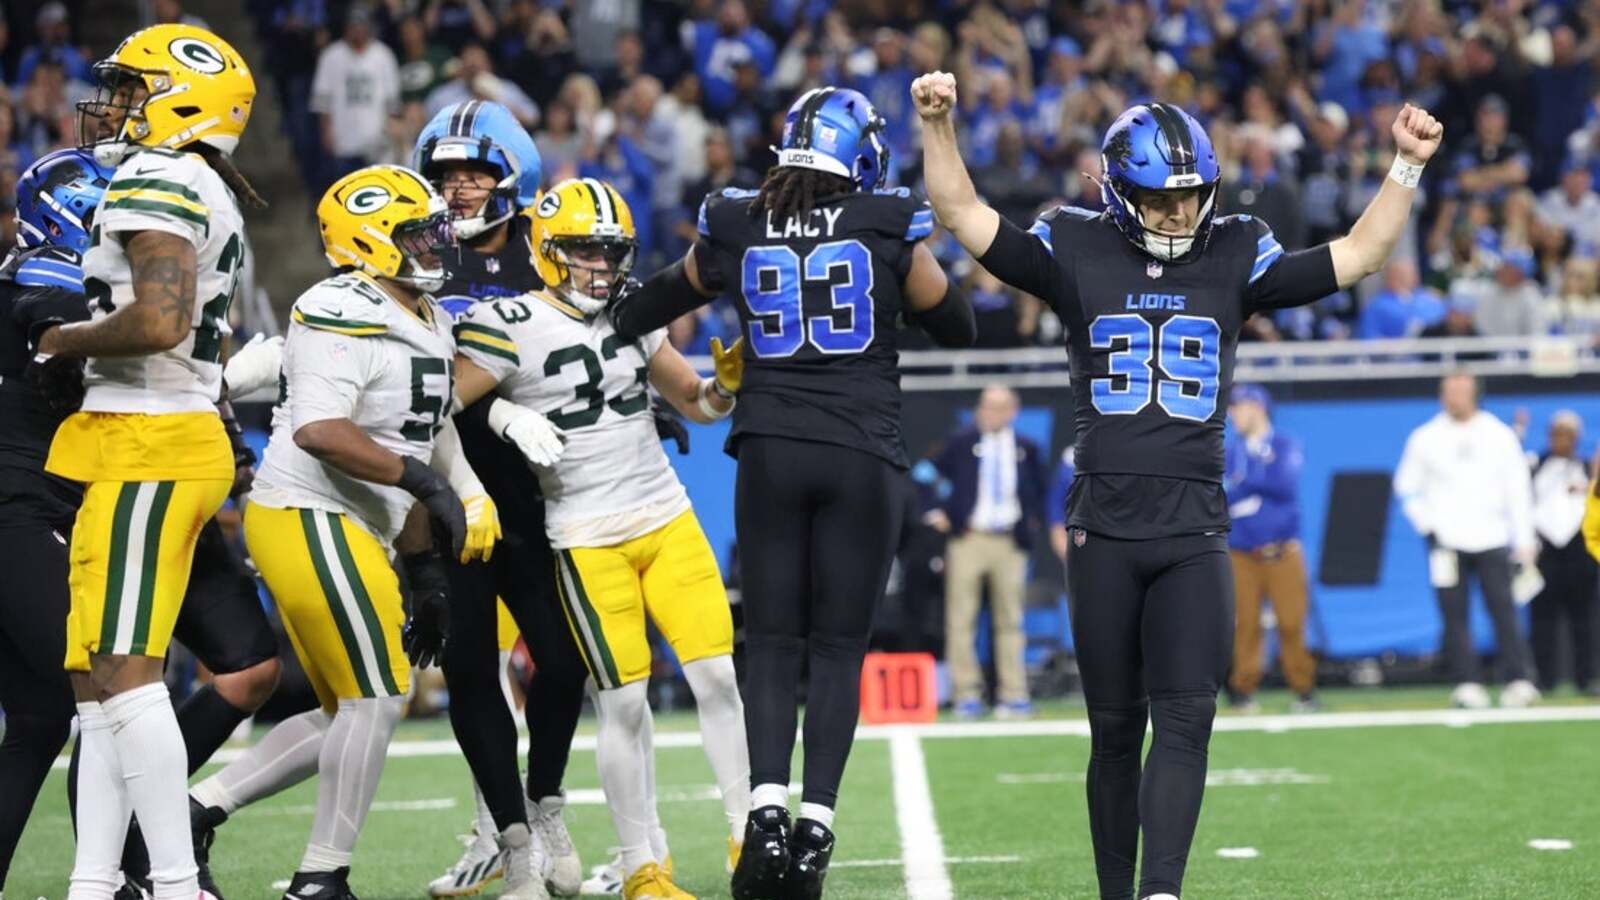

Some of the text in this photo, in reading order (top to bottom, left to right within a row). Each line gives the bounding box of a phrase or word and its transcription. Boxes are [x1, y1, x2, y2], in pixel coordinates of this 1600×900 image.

[765, 207, 844, 238] LACY
[741, 239, 875, 359] 93
[1126, 293, 1187, 310] LIONS
[400, 356, 455, 442] 5
[543, 333, 649, 431] 33
[1088, 313, 1222, 423] 39
[878, 666, 921, 711] 10
